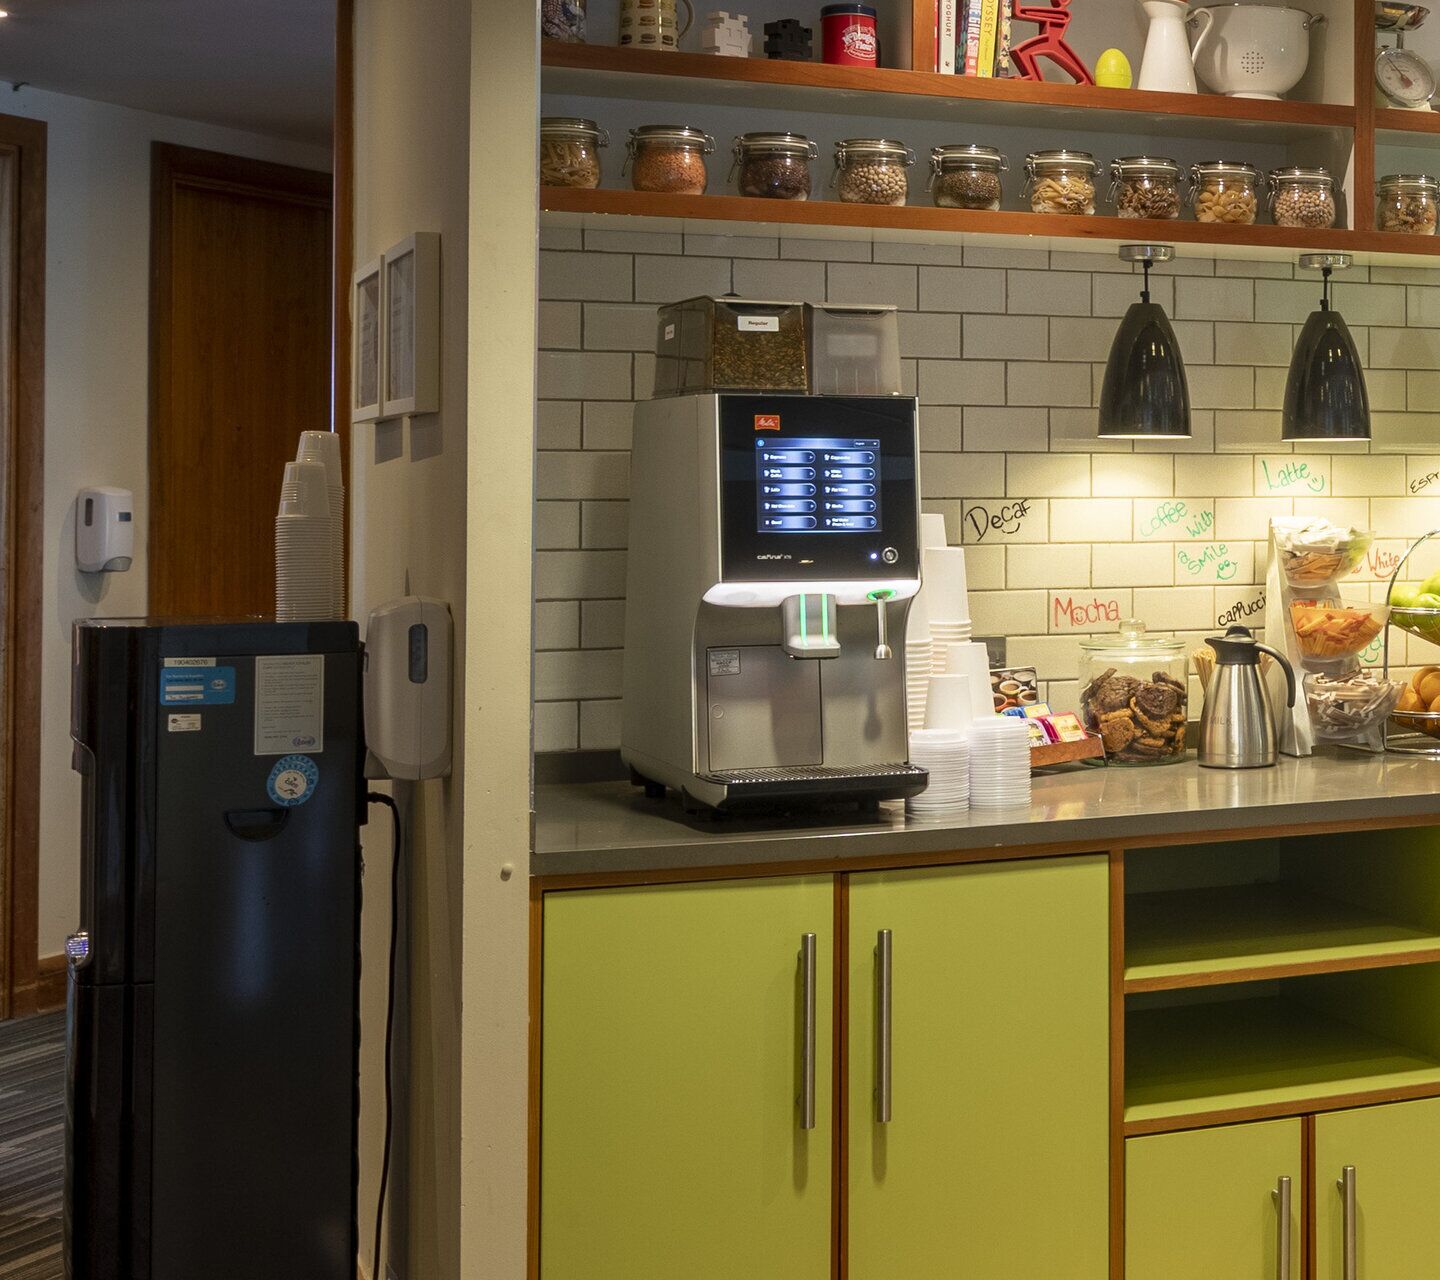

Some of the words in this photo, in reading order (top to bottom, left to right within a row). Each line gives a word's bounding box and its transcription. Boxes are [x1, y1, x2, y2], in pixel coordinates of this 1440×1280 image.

[967, 16, 981, 45] GIRLS
[1262, 460, 1311, 490] Latte
[1367, 548, 1400, 572] White
[1054, 597, 1121, 628] Mocha
[1218, 591, 1267, 627] cappucci
